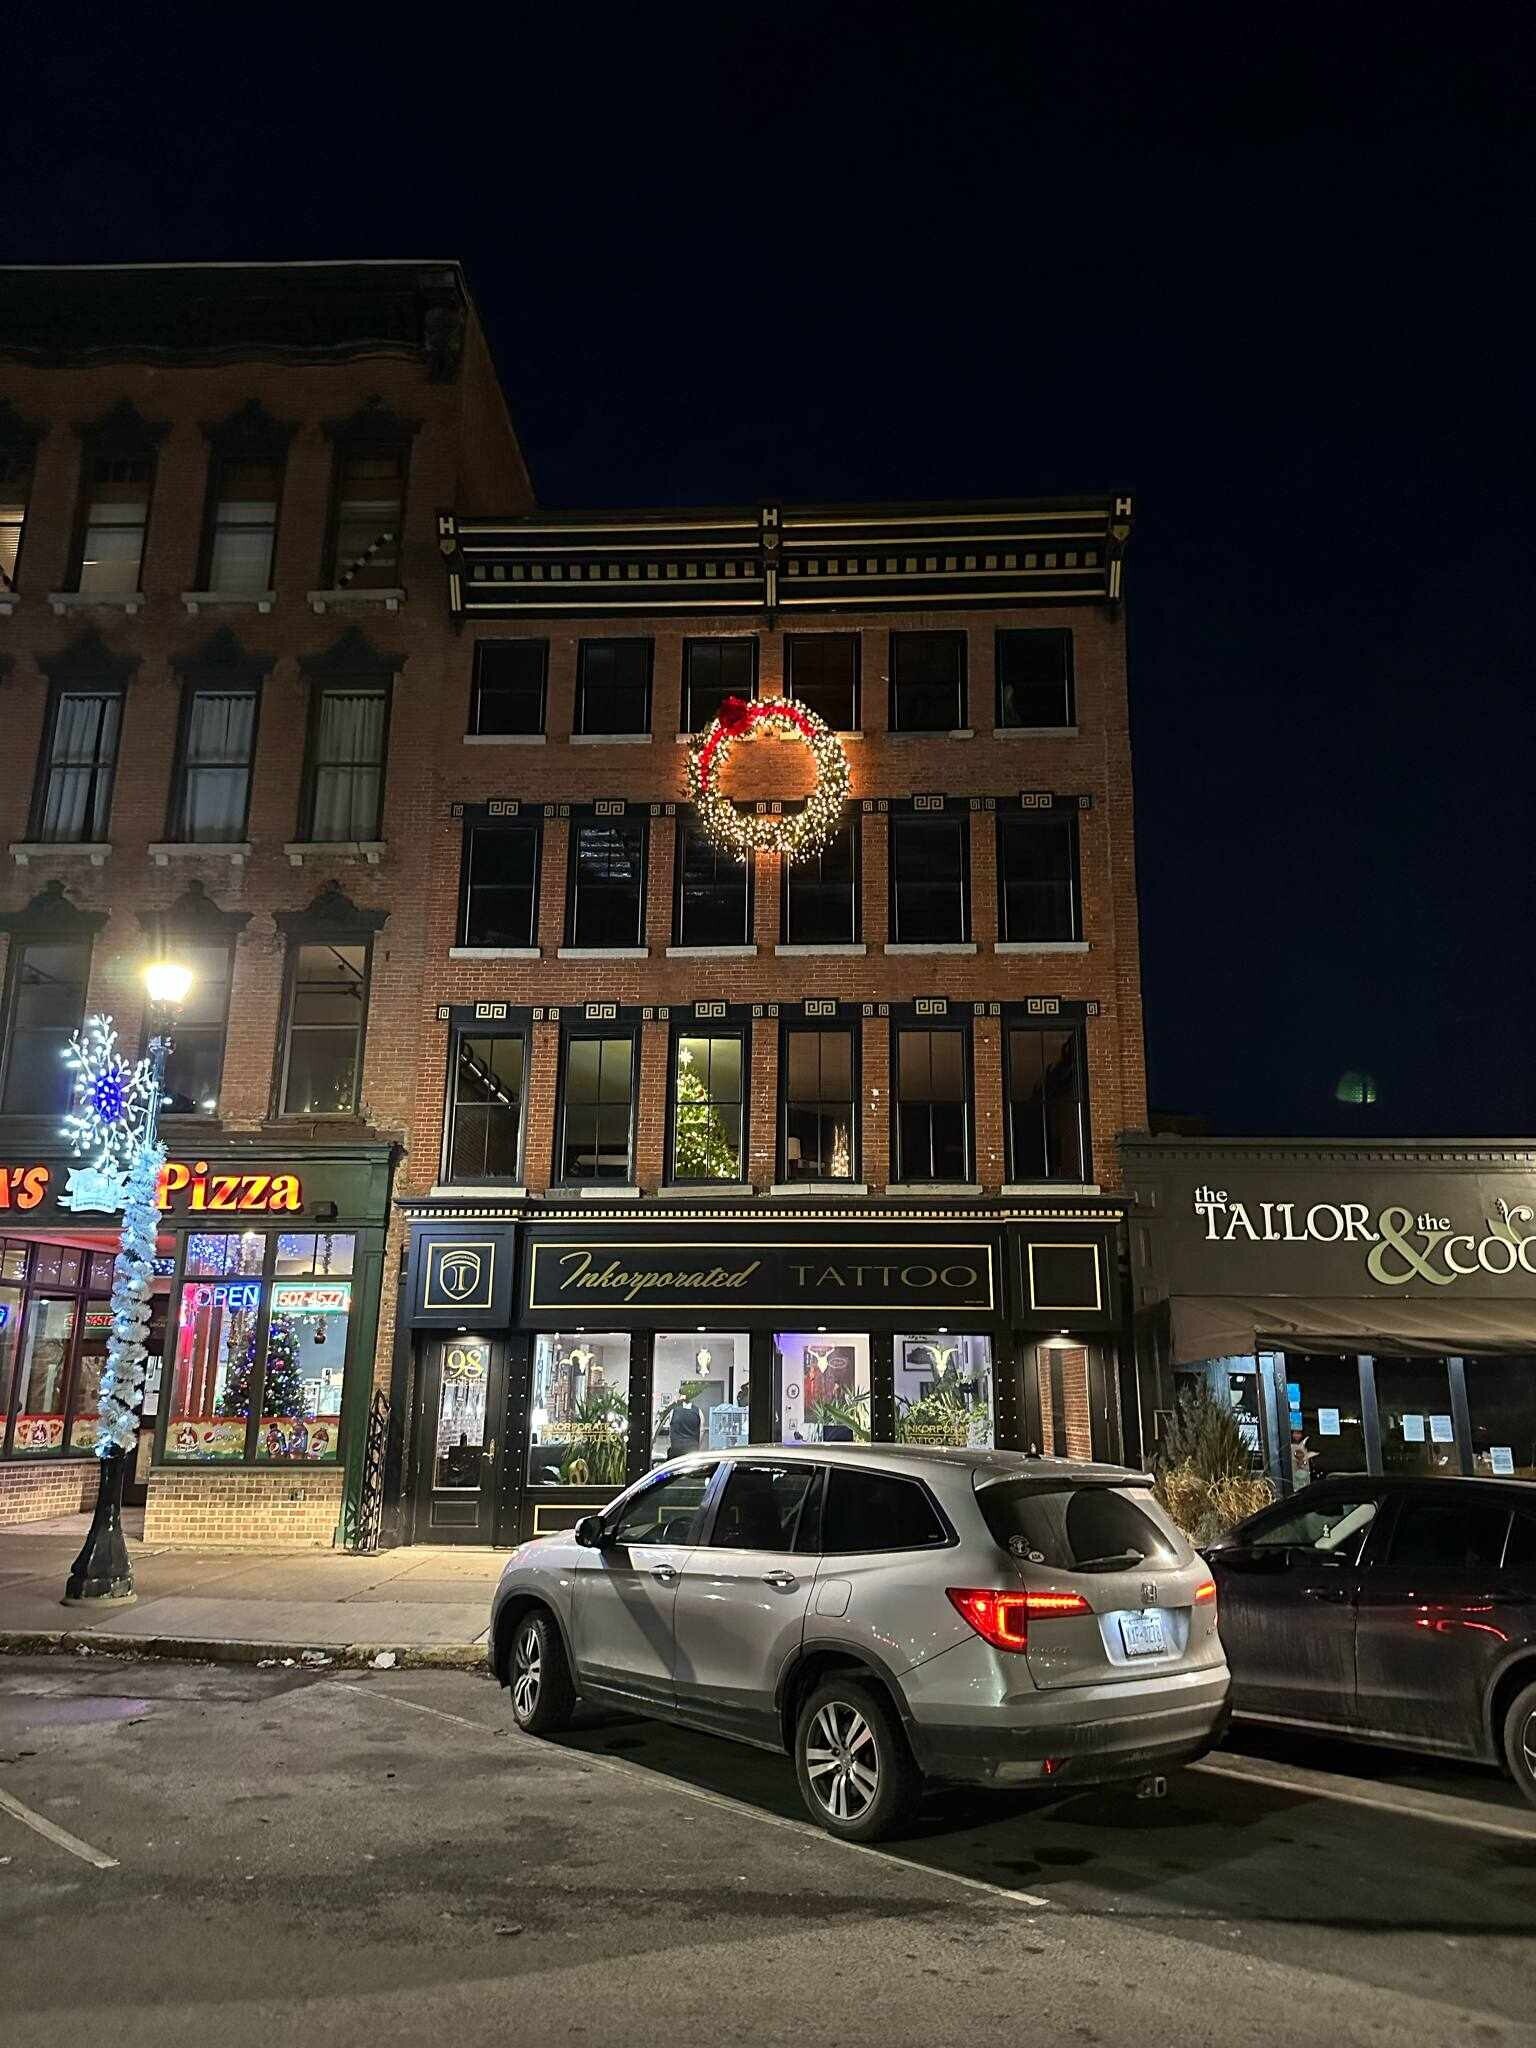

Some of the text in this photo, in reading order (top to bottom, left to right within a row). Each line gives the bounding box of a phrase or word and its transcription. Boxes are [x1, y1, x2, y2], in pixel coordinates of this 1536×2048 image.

[763, 508, 778, 526] H
[0, 1166, 49, 1209] 'S
[156, 1161, 302, 1210] Pizza
[1195, 1185, 1228, 1203] the
[1417, 1213, 1451, 1231] the
[1195, 1202, 1457, 1285] TAILOR &
[559, 1250, 979, 1301] Inkorporated TATTOO
[196, 1285, 259, 1307] OPEN
[447, 1349, 484, 1379] 98
